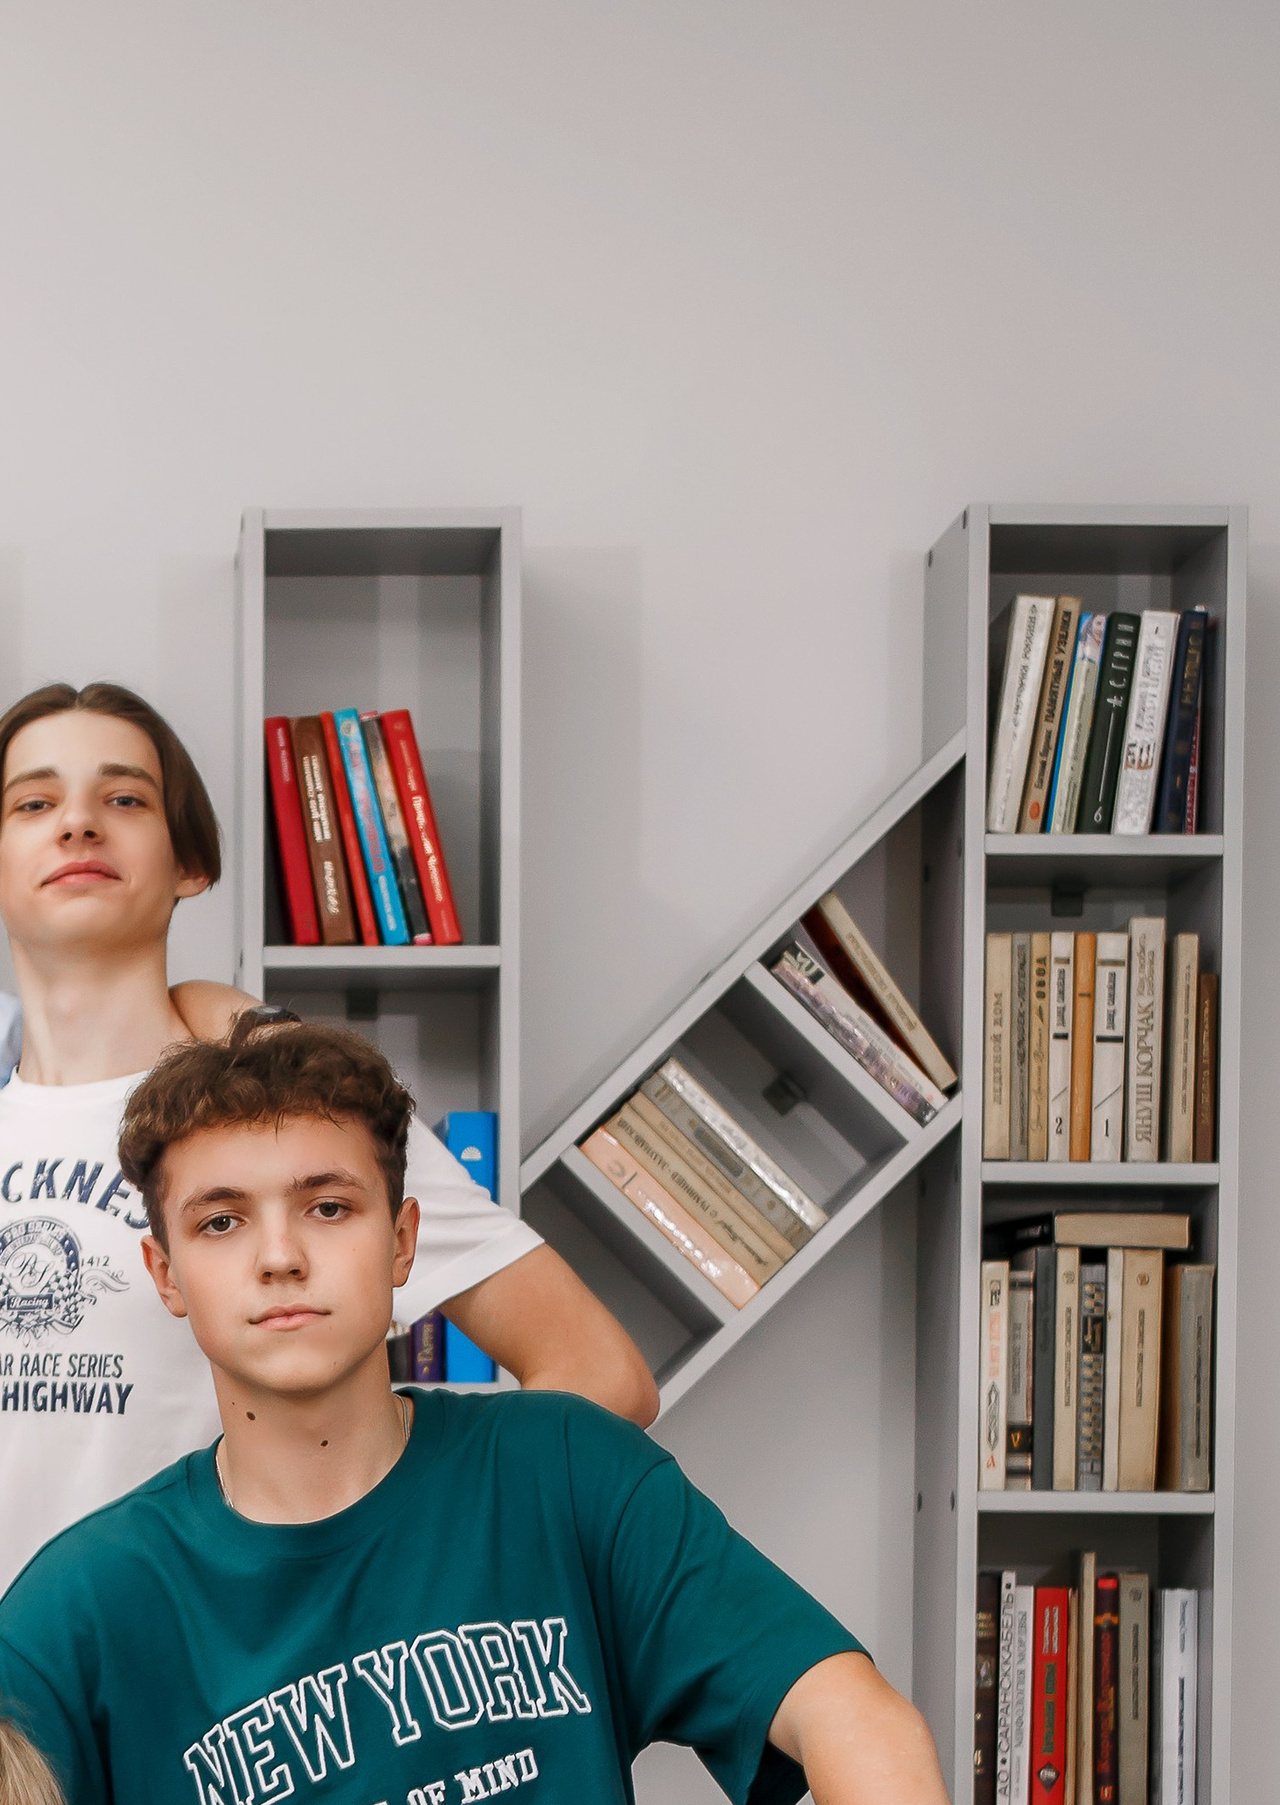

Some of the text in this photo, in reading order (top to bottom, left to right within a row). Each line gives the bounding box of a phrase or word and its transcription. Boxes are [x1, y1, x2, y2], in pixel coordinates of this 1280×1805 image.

[1042, 659, 1064, 722] ПАМЯТНЫЕ
[1035, 956, 1046, 999] ОВОД
[992, 992, 1002, 1026] ДОМ
[1136, 1000, 1153, 1143] ЯНУШ КОРЧАК
[1055, 1117, 1062, 1135] 2
[1104, 1119, 1109, 1137] 1
[10, 1295, 49, 1308] Racing
[20, 1353, 62, 1377] RACE
[67, 1353, 124, 1378] SERIES
[2, 1381, 134, 1415] HIGHWAY
[353, 1616, 592, 1747] YORK
[997, 1594, 1014, 1797] АО САРАНСККАБЕЛЬ
[455, 1748, 539, 1805] MIND
